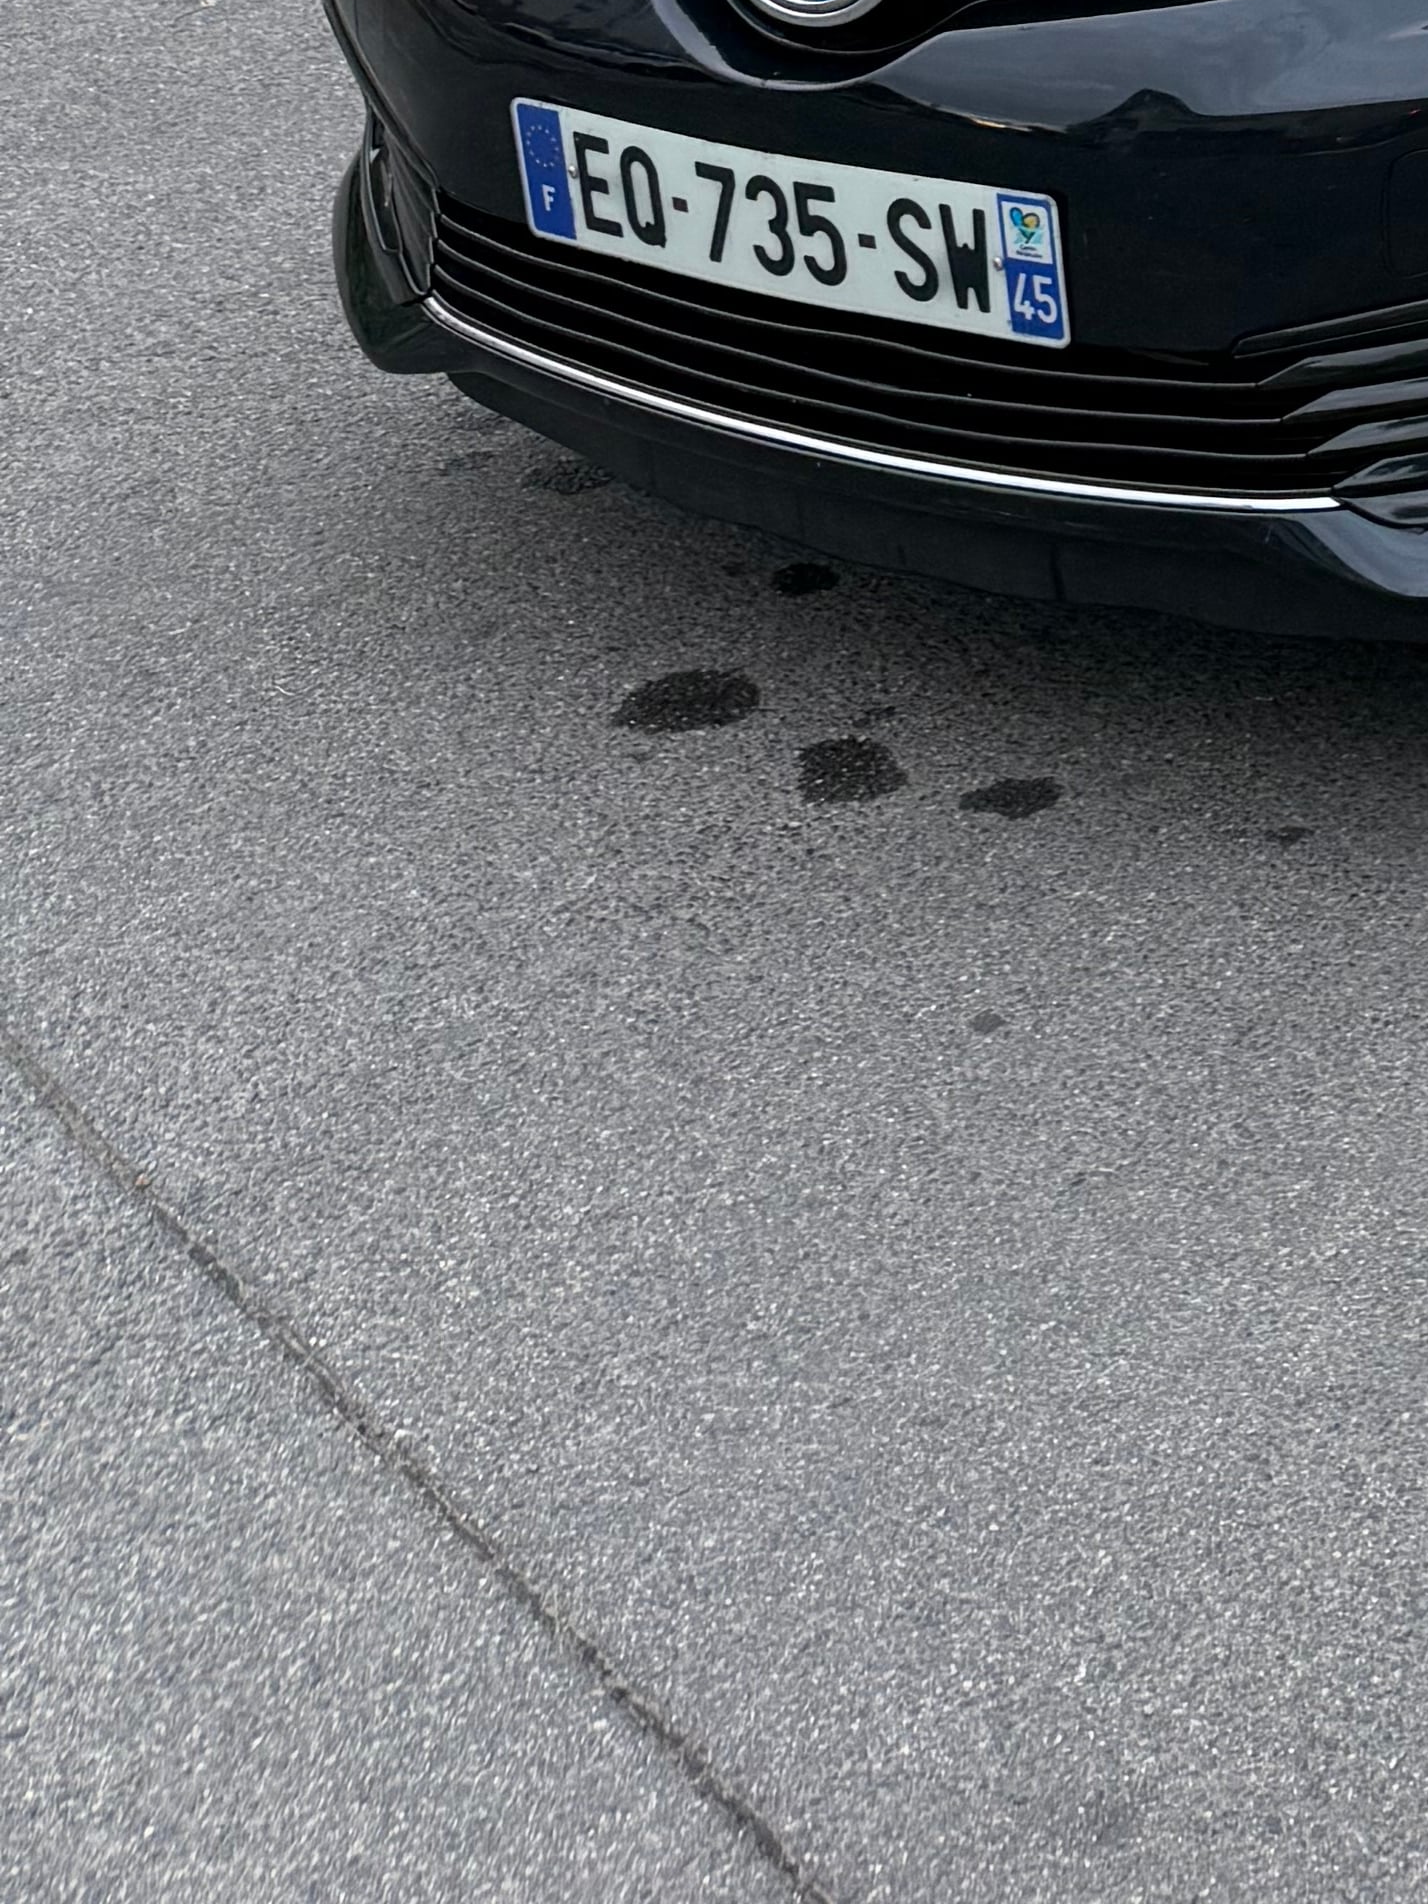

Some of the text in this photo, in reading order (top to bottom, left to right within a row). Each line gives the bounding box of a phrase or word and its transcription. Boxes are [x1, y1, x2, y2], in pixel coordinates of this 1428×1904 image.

[542, 183, 556, 212] F
[573, 131, 991, 313] EQ-735-SW
[1013, 272, 1058, 324] 45
